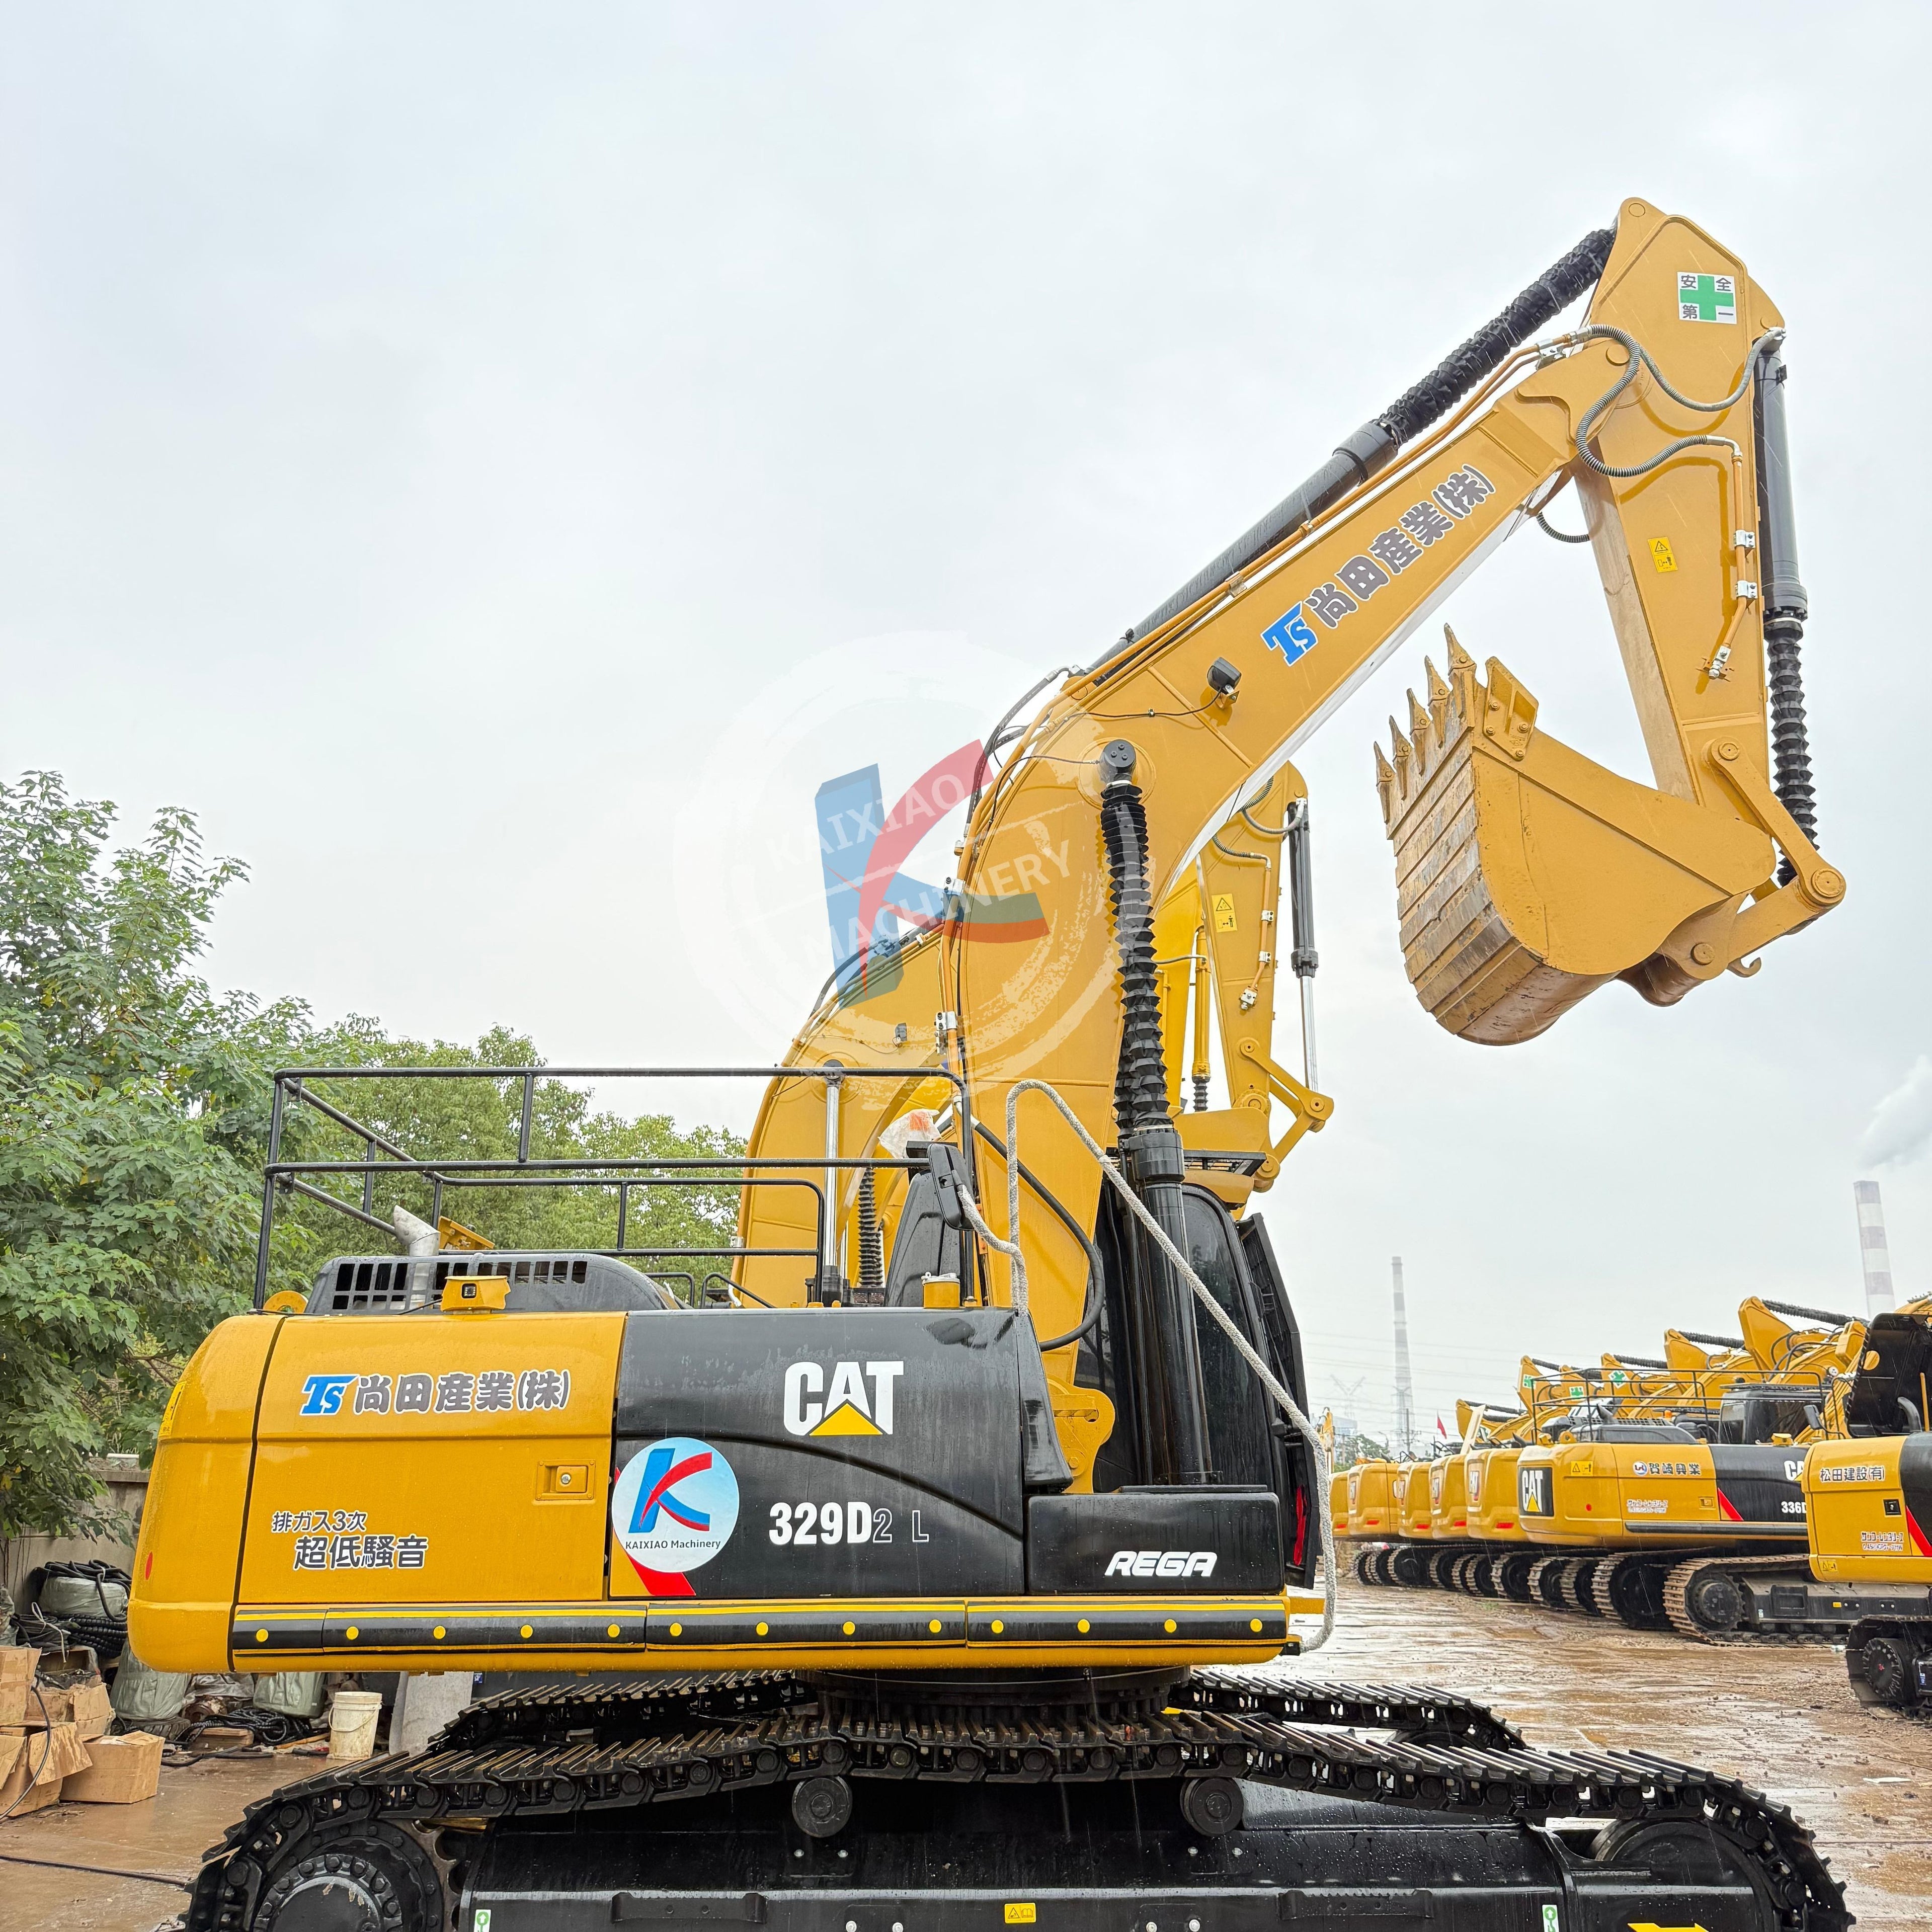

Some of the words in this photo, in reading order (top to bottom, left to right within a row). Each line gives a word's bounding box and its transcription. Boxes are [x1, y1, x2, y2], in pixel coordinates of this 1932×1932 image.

[1304, 464, 1496, 629] 尚田産業(株)
[354, 1369, 571, 1415] 尚田産業(株)
[783, 1361, 904, 1435] CAT
[1522, 1470, 1543, 1512] CAT
[1820, 1467, 1885, 1482] 松田建設(有)
[271, 1509, 368, 1533] 排ガス3次
[912, 1510, 930, 1542] L
[293, 1534, 428, 1570] 超低騒音
[625, 1540, 668, 1550] KAIXIAO
[671, 1539, 721, 1550] Machinery
[1105, 1551, 1218, 1577] REGA
